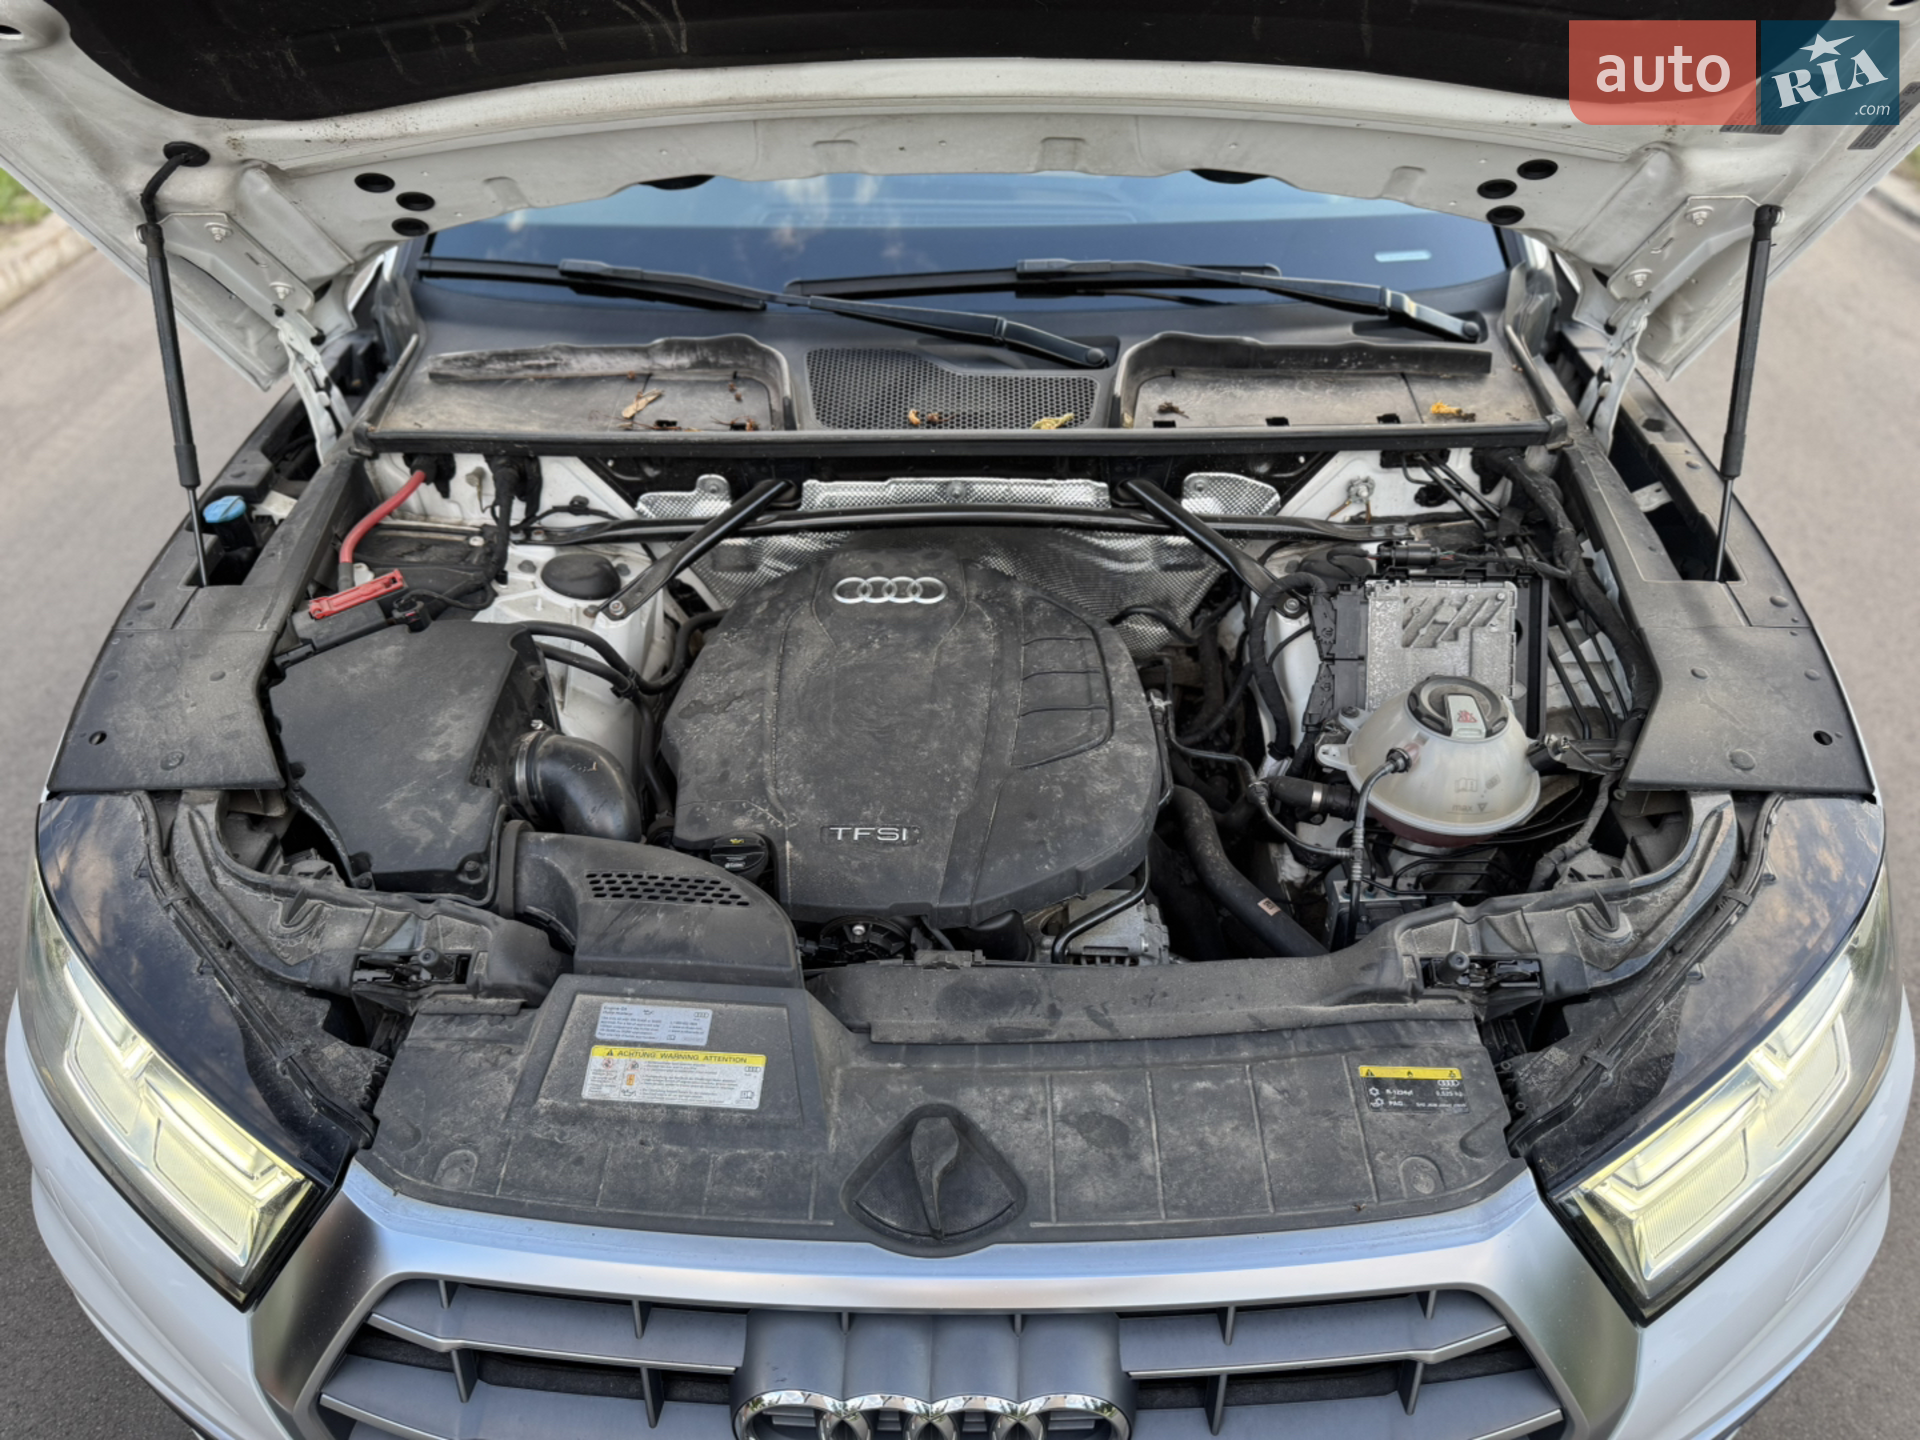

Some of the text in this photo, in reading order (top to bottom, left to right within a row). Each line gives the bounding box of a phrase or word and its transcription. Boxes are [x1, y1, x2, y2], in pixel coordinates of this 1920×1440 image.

[1452, 804, 1473, 812] max
[829, 827, 907, 840] TFSI
[617, 1050, 747, 1064] ACHTUNG WARNING ATTENTION
